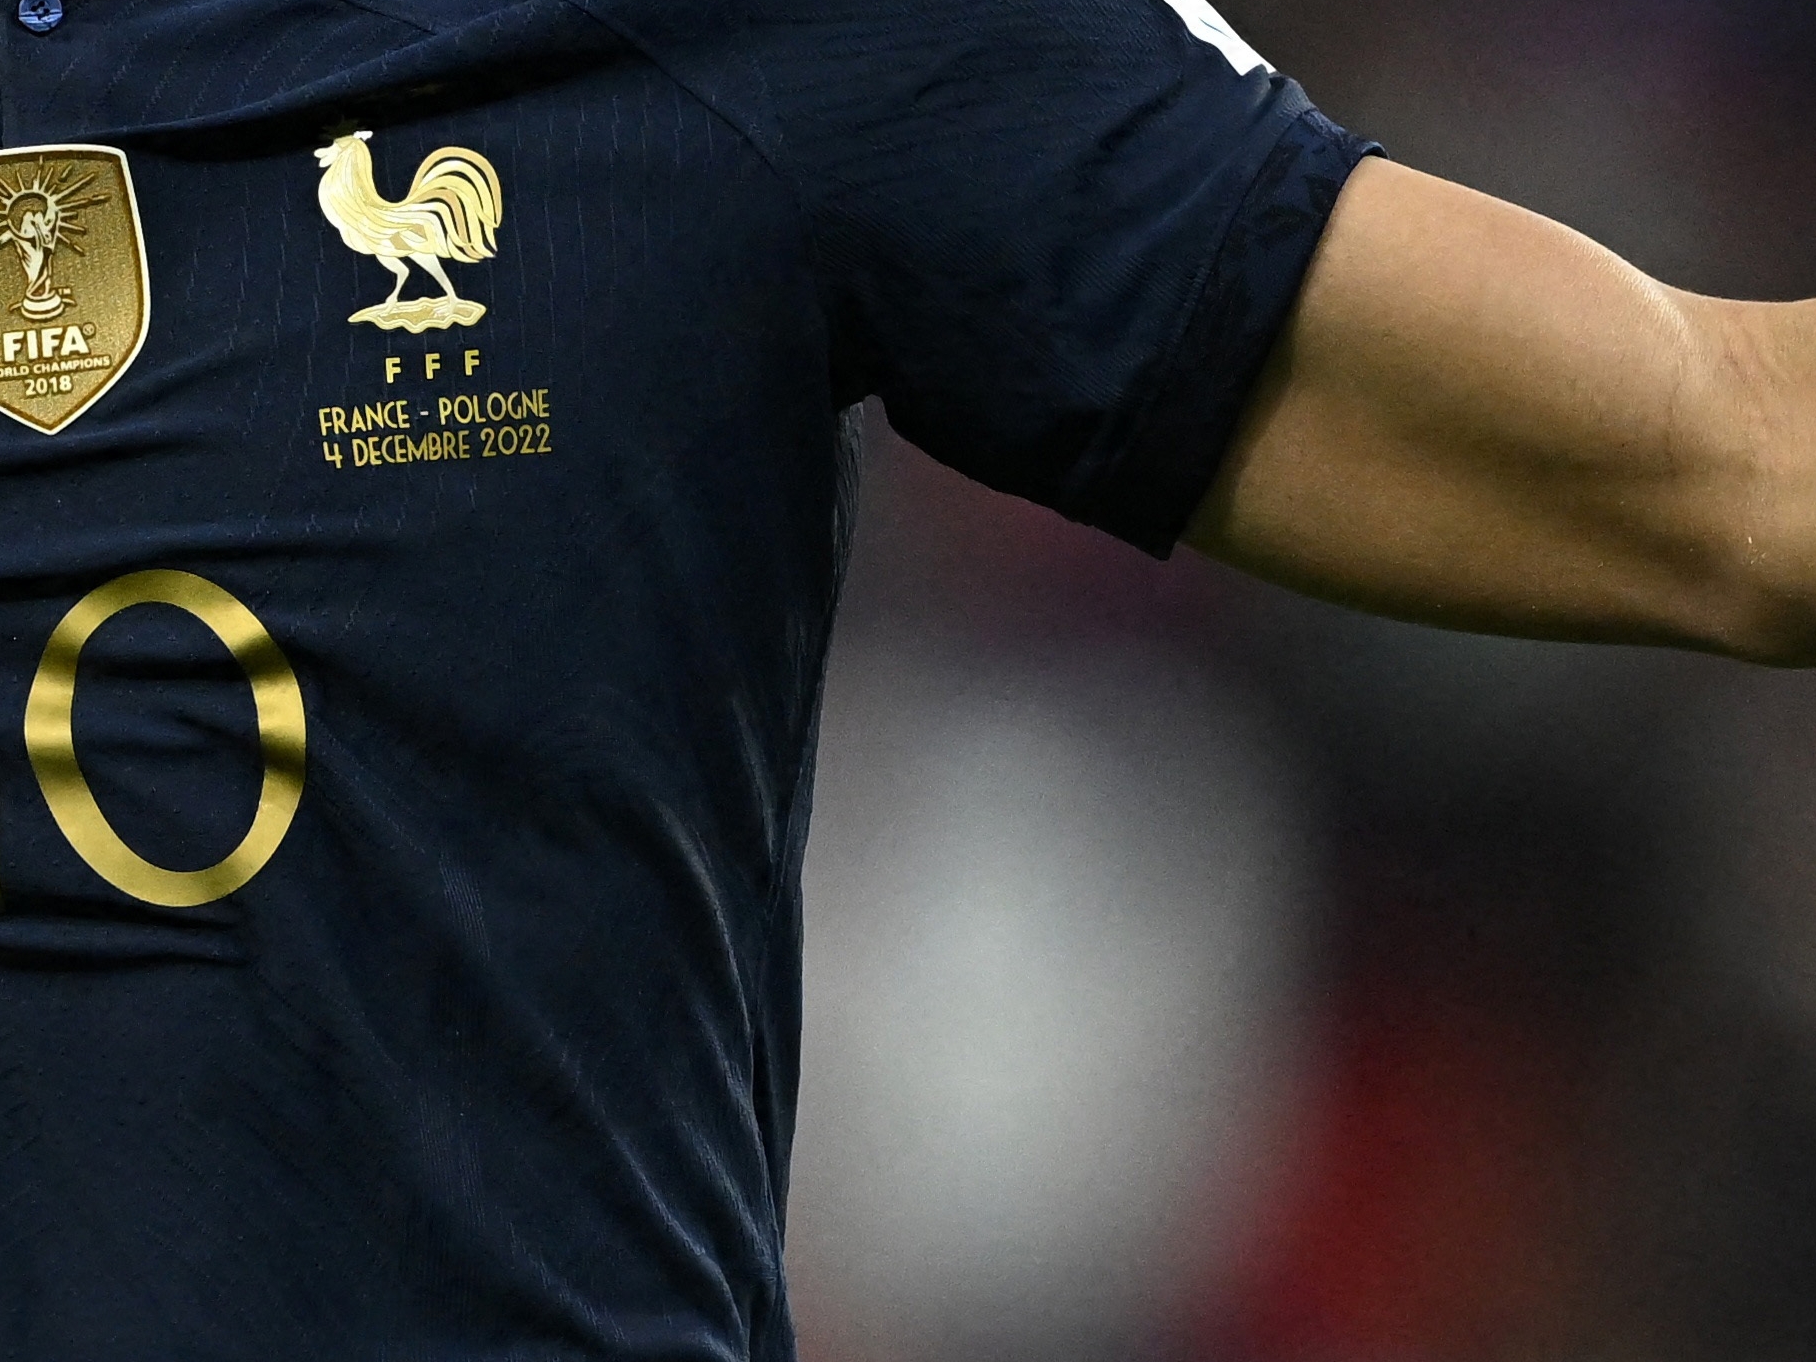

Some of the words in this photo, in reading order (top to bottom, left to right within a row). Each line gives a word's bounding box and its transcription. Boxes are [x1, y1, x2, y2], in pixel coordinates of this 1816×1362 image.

[2, 325, 89, 362] FIFA
[33, 356, 110, 375] CHAMPIONS
[384, 356, 402, 384] F
[425, 352, 441, 380] F
[464, 349, 480, 376] F
[24, 376, 72, 395] 2018
[318, 399, 411, 436] FRANCE
[438, 388, 550, 425] POLOGNE
[322, 441, 343, 469] 4
[352, 429, 471, 467] DECEMBRE
[480, 423, 553, 458] 2022
